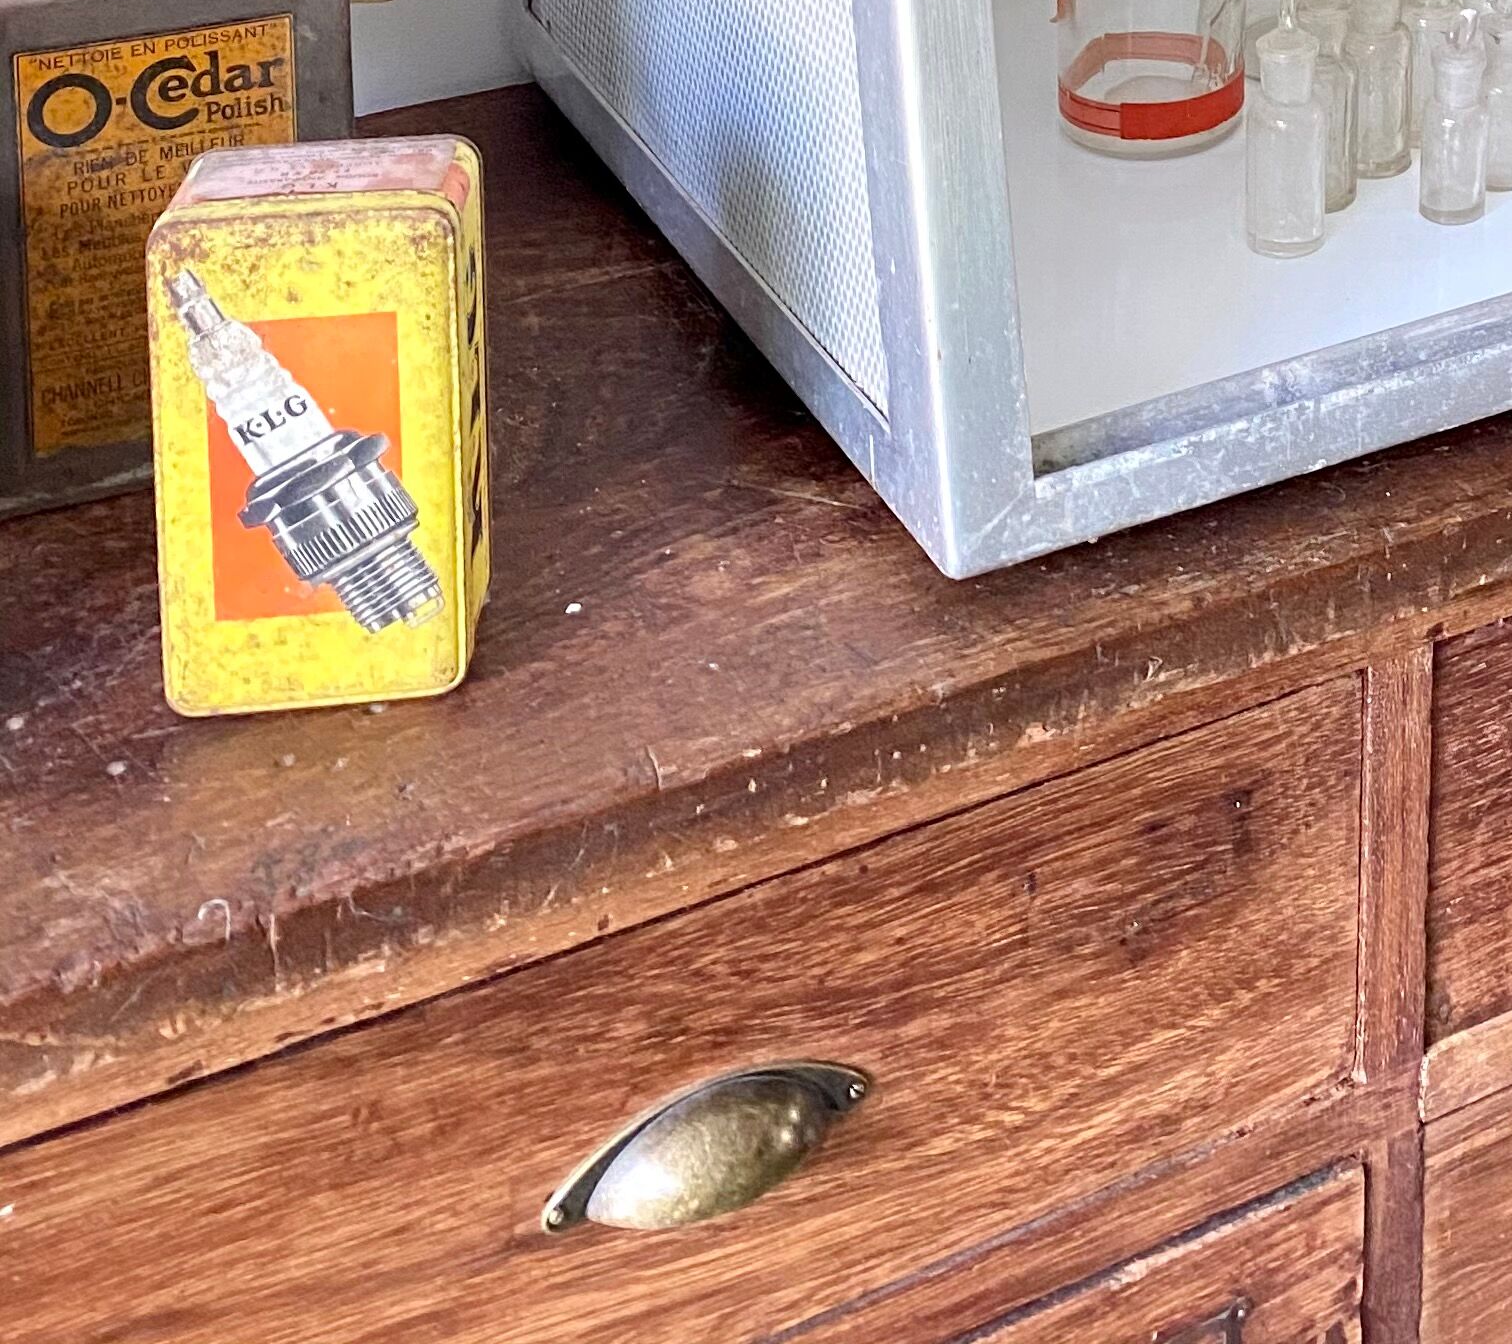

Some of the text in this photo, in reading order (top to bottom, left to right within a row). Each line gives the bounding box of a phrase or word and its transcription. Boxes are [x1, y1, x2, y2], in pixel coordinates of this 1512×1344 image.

[130, 42, 156, 58] EN
[27, 50, 286, 148] O-Cedar
[205, 95, 285, 123] Polish
[125, 150, 148, 166] DE
[159, 133, 245, 161] MEILLEUR
[66, 172, 127, 196] POUR
[142, 165, 166, 183] LE
[60, 182, 182, 219] POUR NETTOYE
